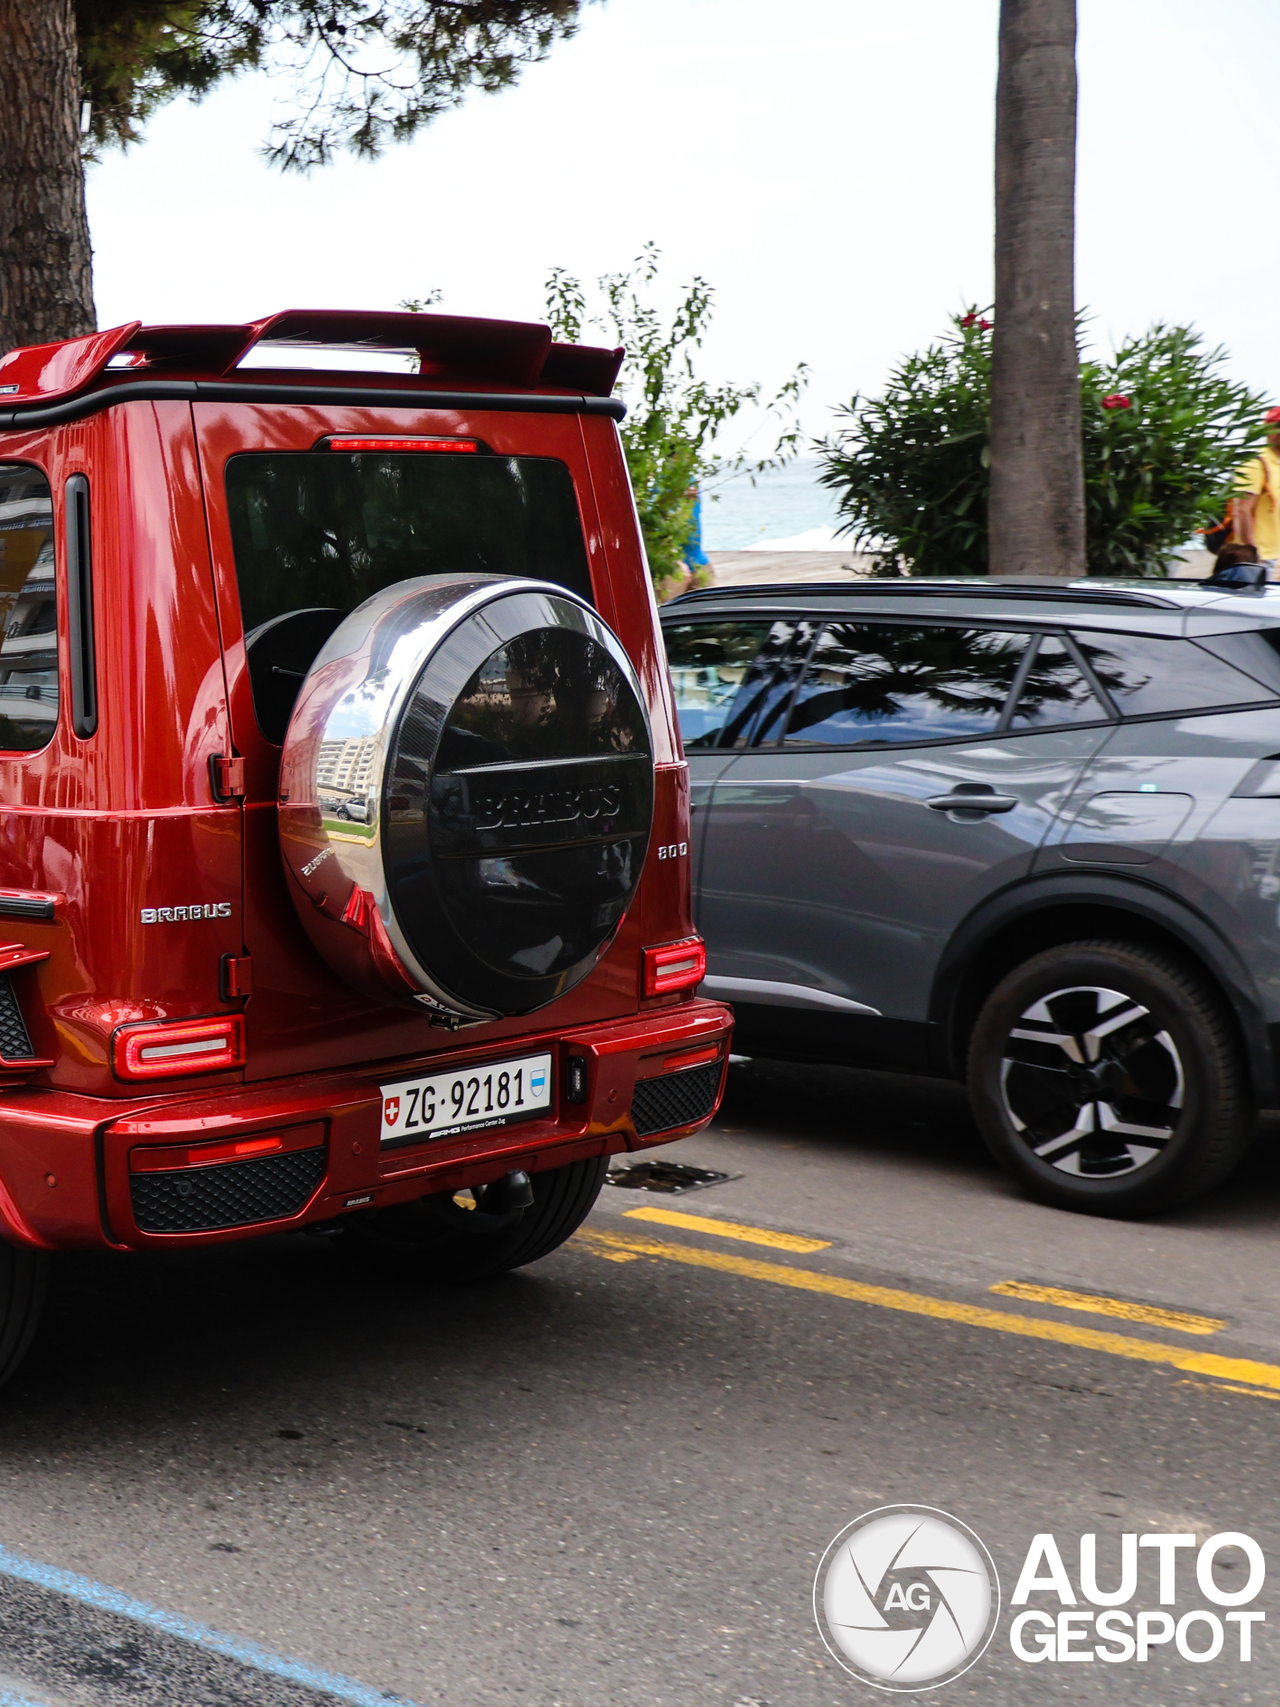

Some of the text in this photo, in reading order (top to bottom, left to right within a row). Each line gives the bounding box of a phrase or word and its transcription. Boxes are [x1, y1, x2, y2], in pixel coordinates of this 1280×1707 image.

[475, 784, 622, 831] BRABUS
[657, 842, 688, 861] 800
[140, 902, 232, 924] BRABUS
[461, 1122, 485, 1132] Performance
[484, 1119, 498, 1127] Center
[497, 1117, 506, 1125] Zug
